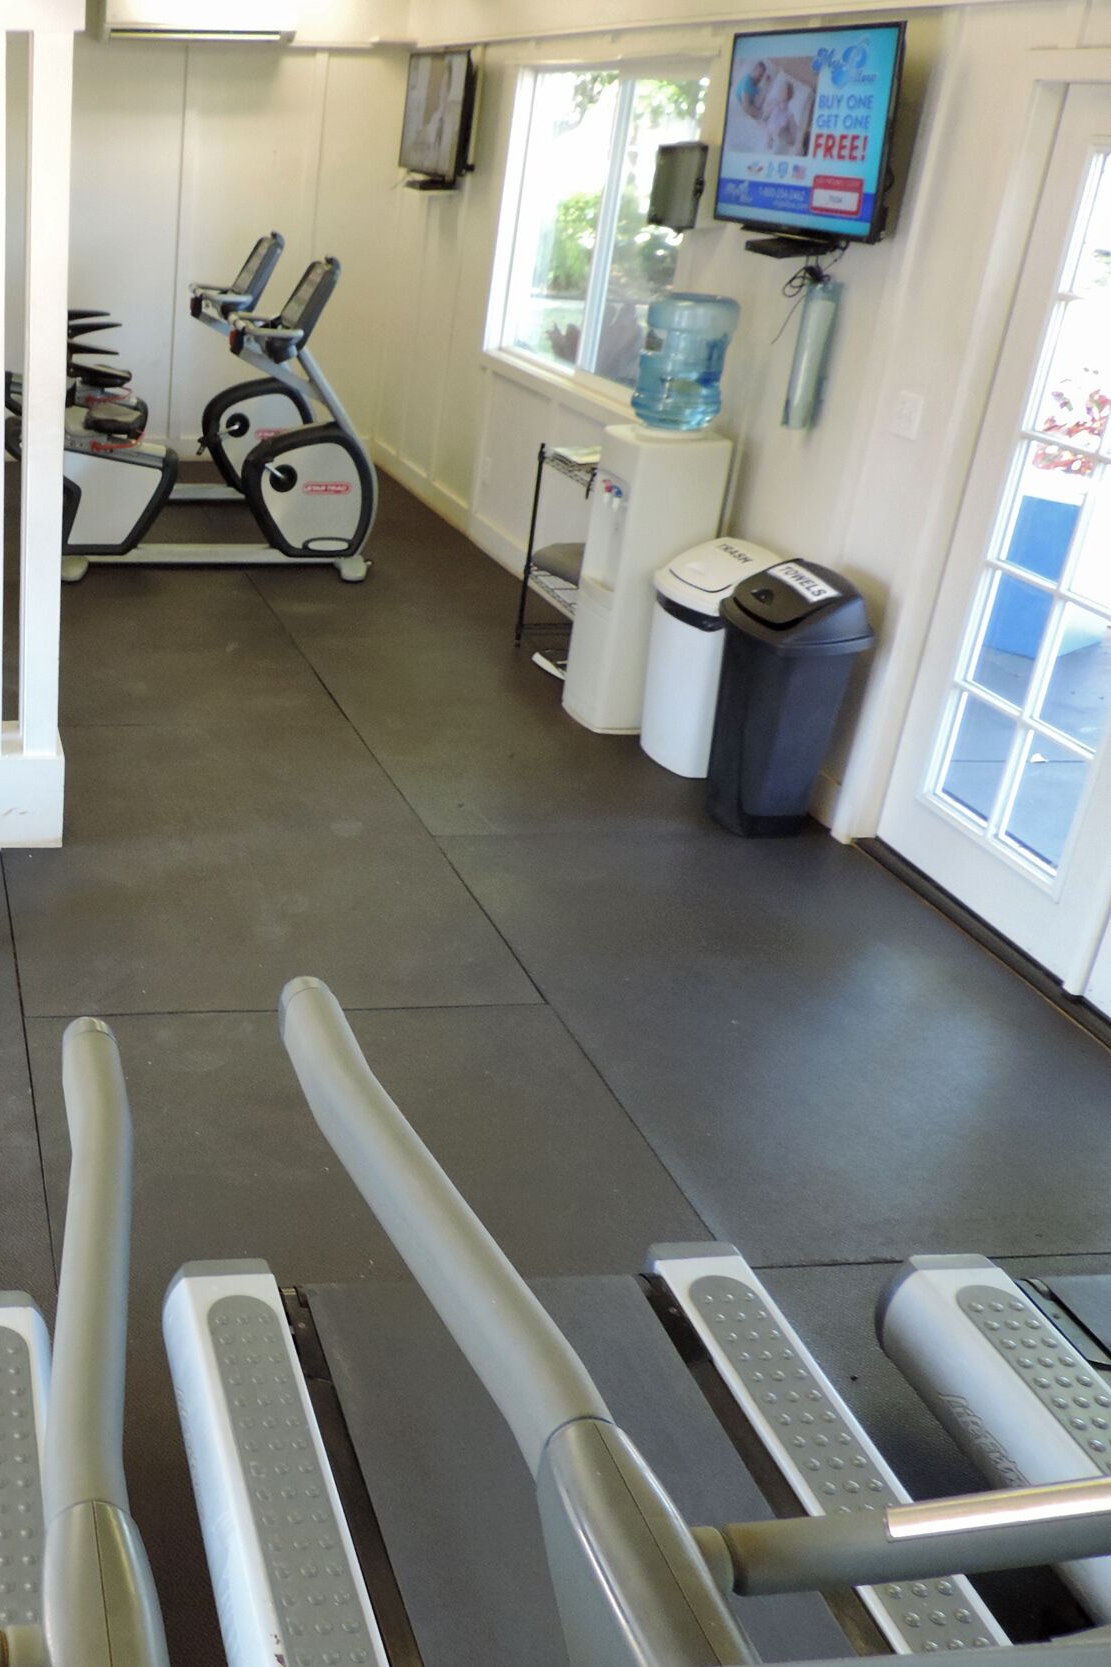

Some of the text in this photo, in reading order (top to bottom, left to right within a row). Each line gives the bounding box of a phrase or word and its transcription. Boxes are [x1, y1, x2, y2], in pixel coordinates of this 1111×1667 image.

[818, 94, 874, 110] BUY ONE
[816, 113, 871, 130] GET ONE
[812, 133, 868, 160] FREE!
[716, 543, 753, 564] TRASH
[778, 565, 827, 597] TOWELS
